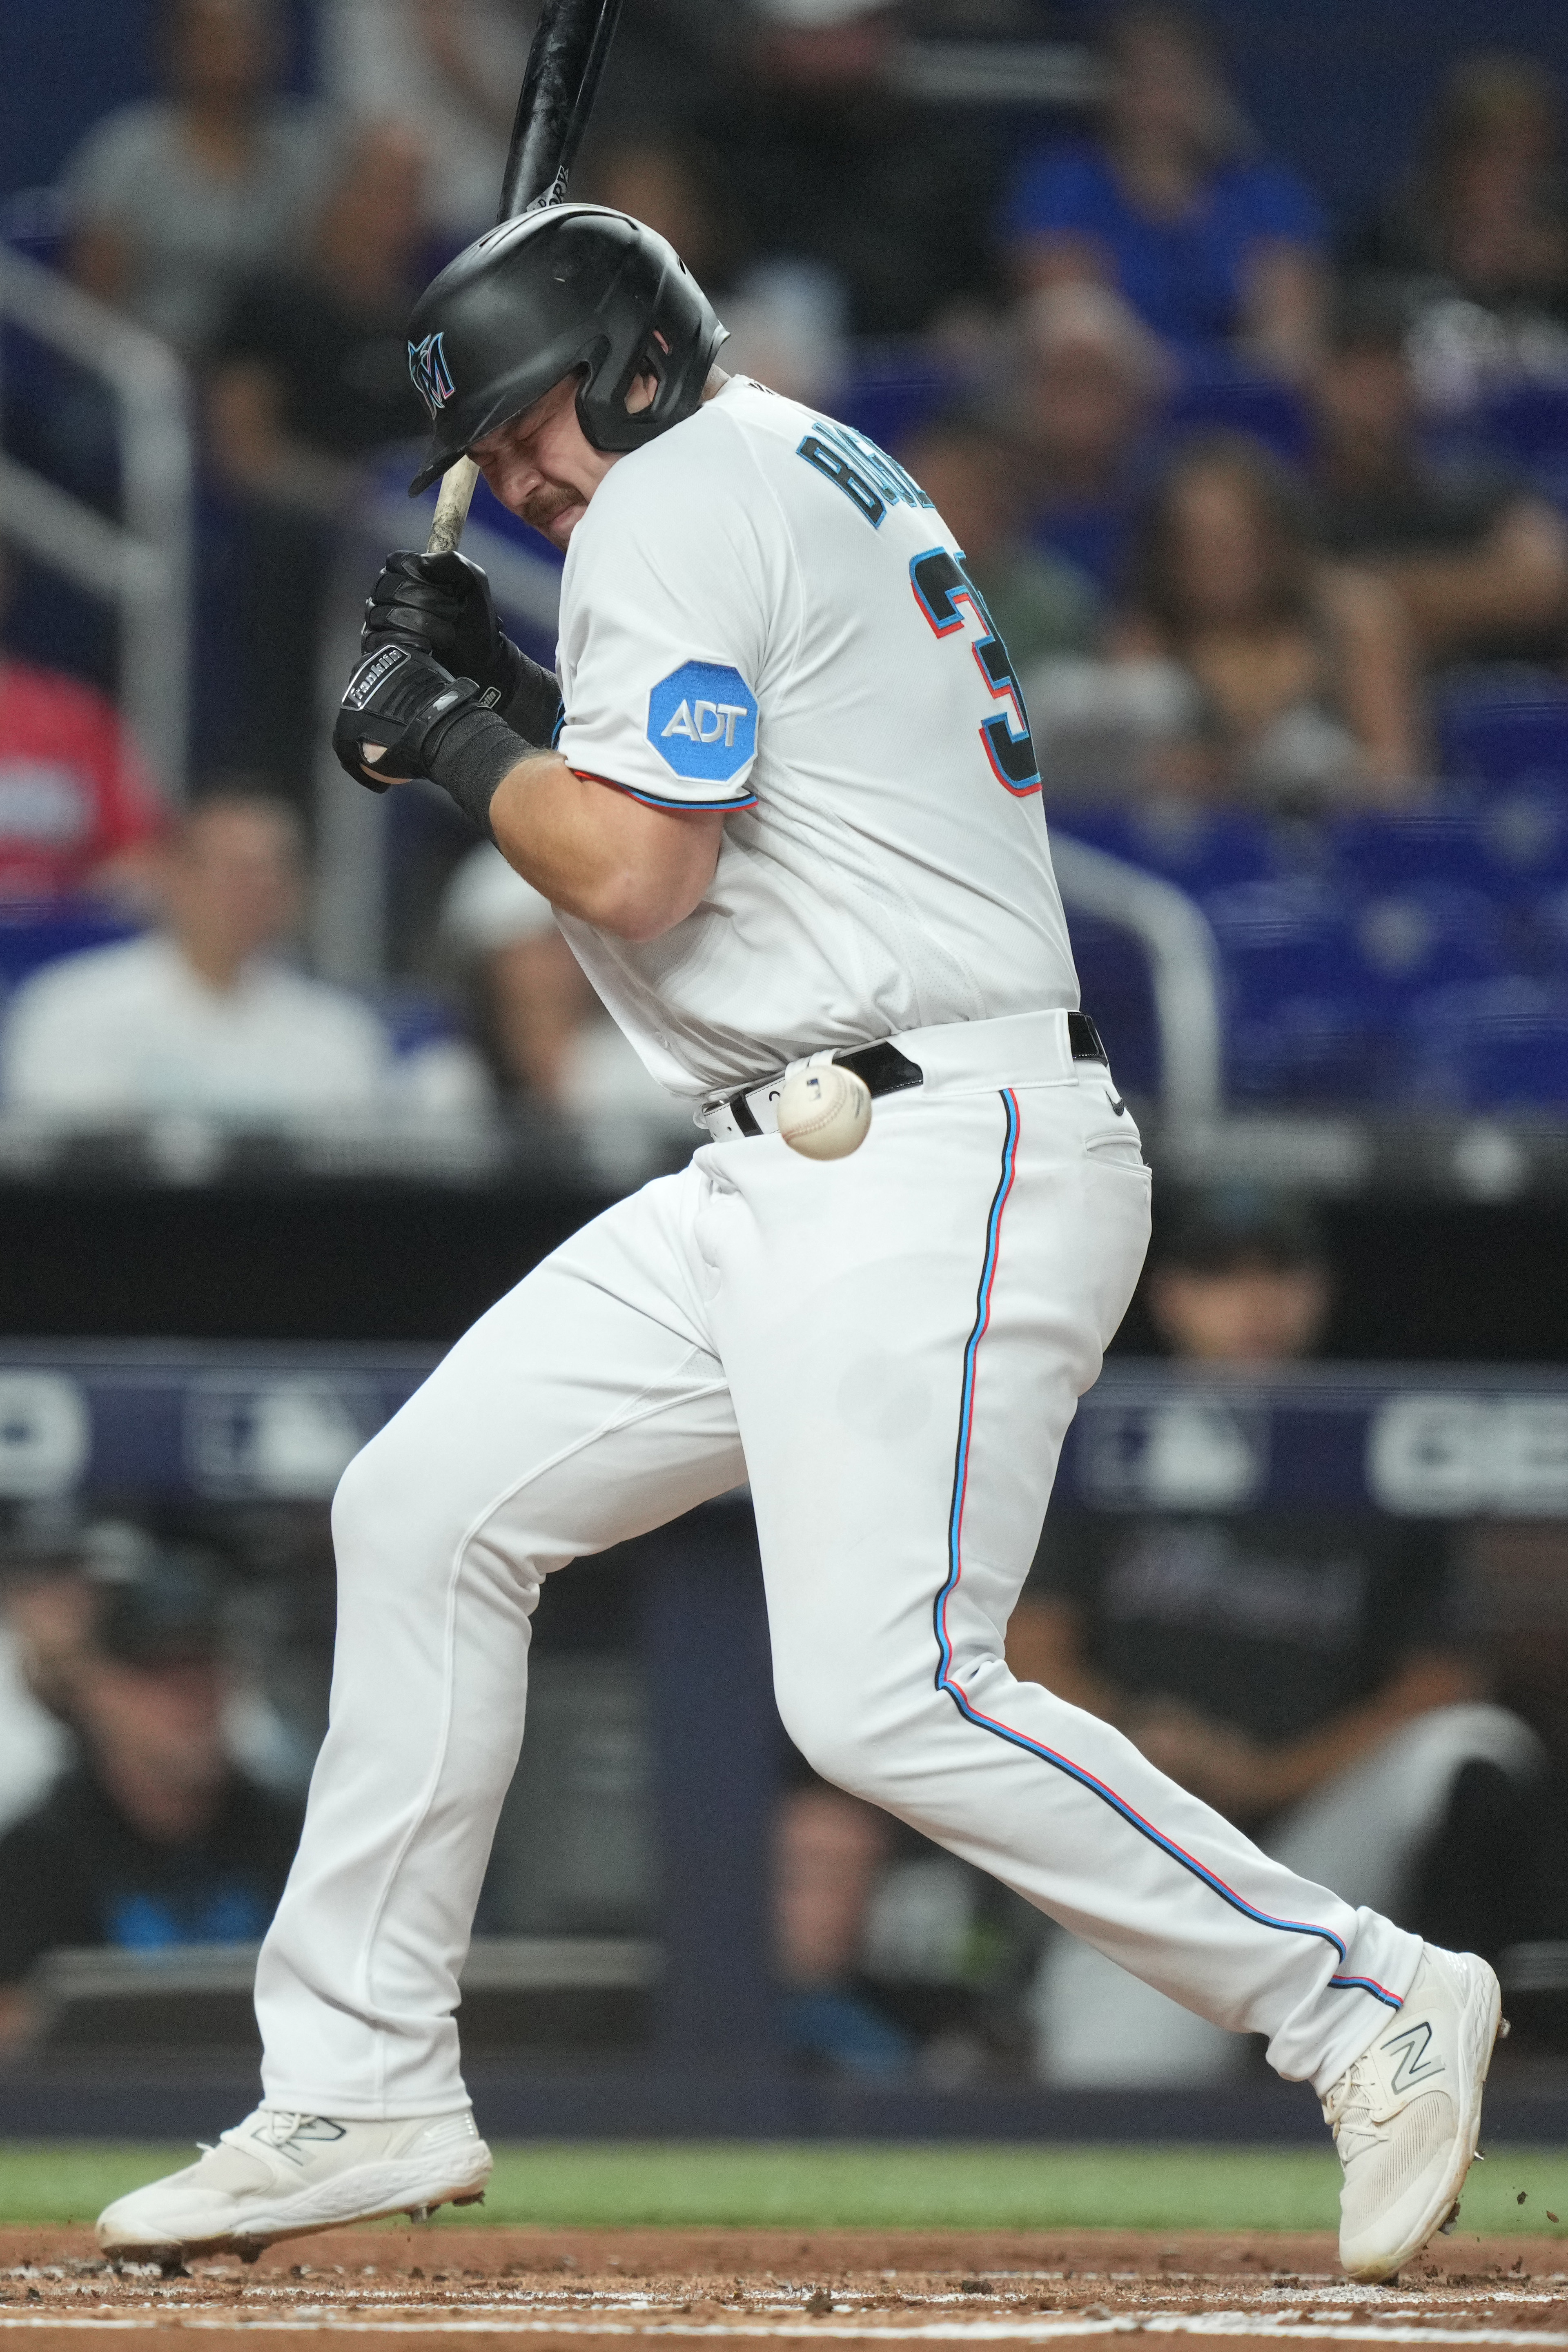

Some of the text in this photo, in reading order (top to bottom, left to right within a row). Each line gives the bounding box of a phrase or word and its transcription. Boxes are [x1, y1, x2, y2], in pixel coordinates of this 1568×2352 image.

[348, 650, 403, 707] Franklin
[909, 546, 1043, 797] 3
[660, 698, 748, 747] ADT
